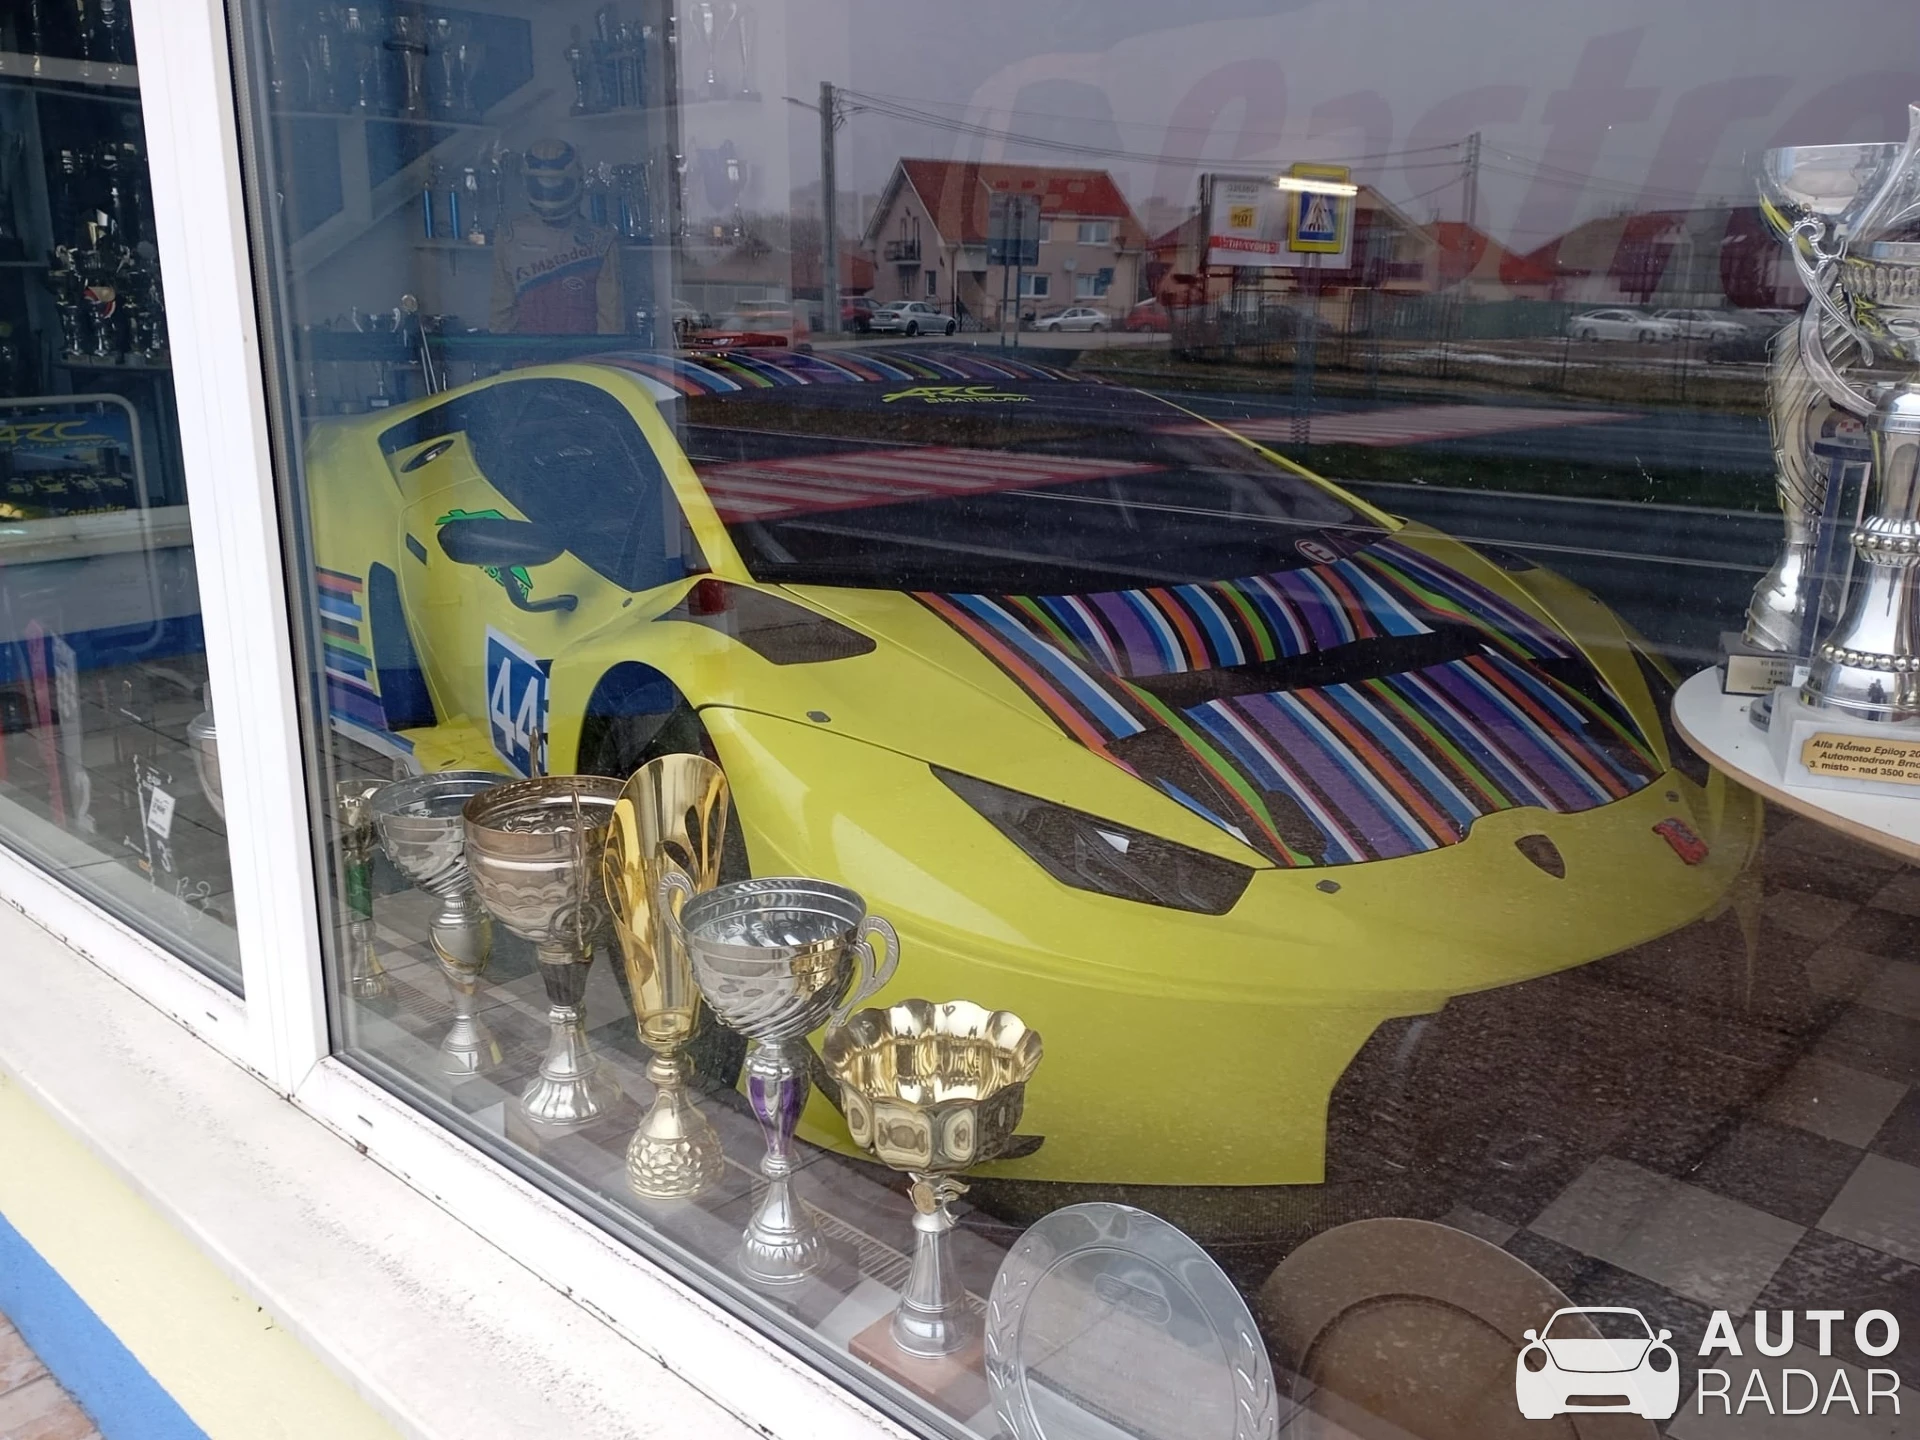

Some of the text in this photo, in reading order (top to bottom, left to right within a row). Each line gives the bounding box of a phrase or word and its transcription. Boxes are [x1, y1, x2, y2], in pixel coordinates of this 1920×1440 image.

[531, 247, 594, 274] Matador
[925, 397, 1035, 405] BRATISLAVA
[491, 657, 542, 763] 44
[1813, 740, 1833, 749] Alfa
[1874, 746, 1906, 758] Epilog
[1820, 751, 1895, 766] Automotodrom
[1859, 767, 1878, 775] nad
[1880, 768, 1904, 777] 3500
[1907, 771, 1920, 779] cc
